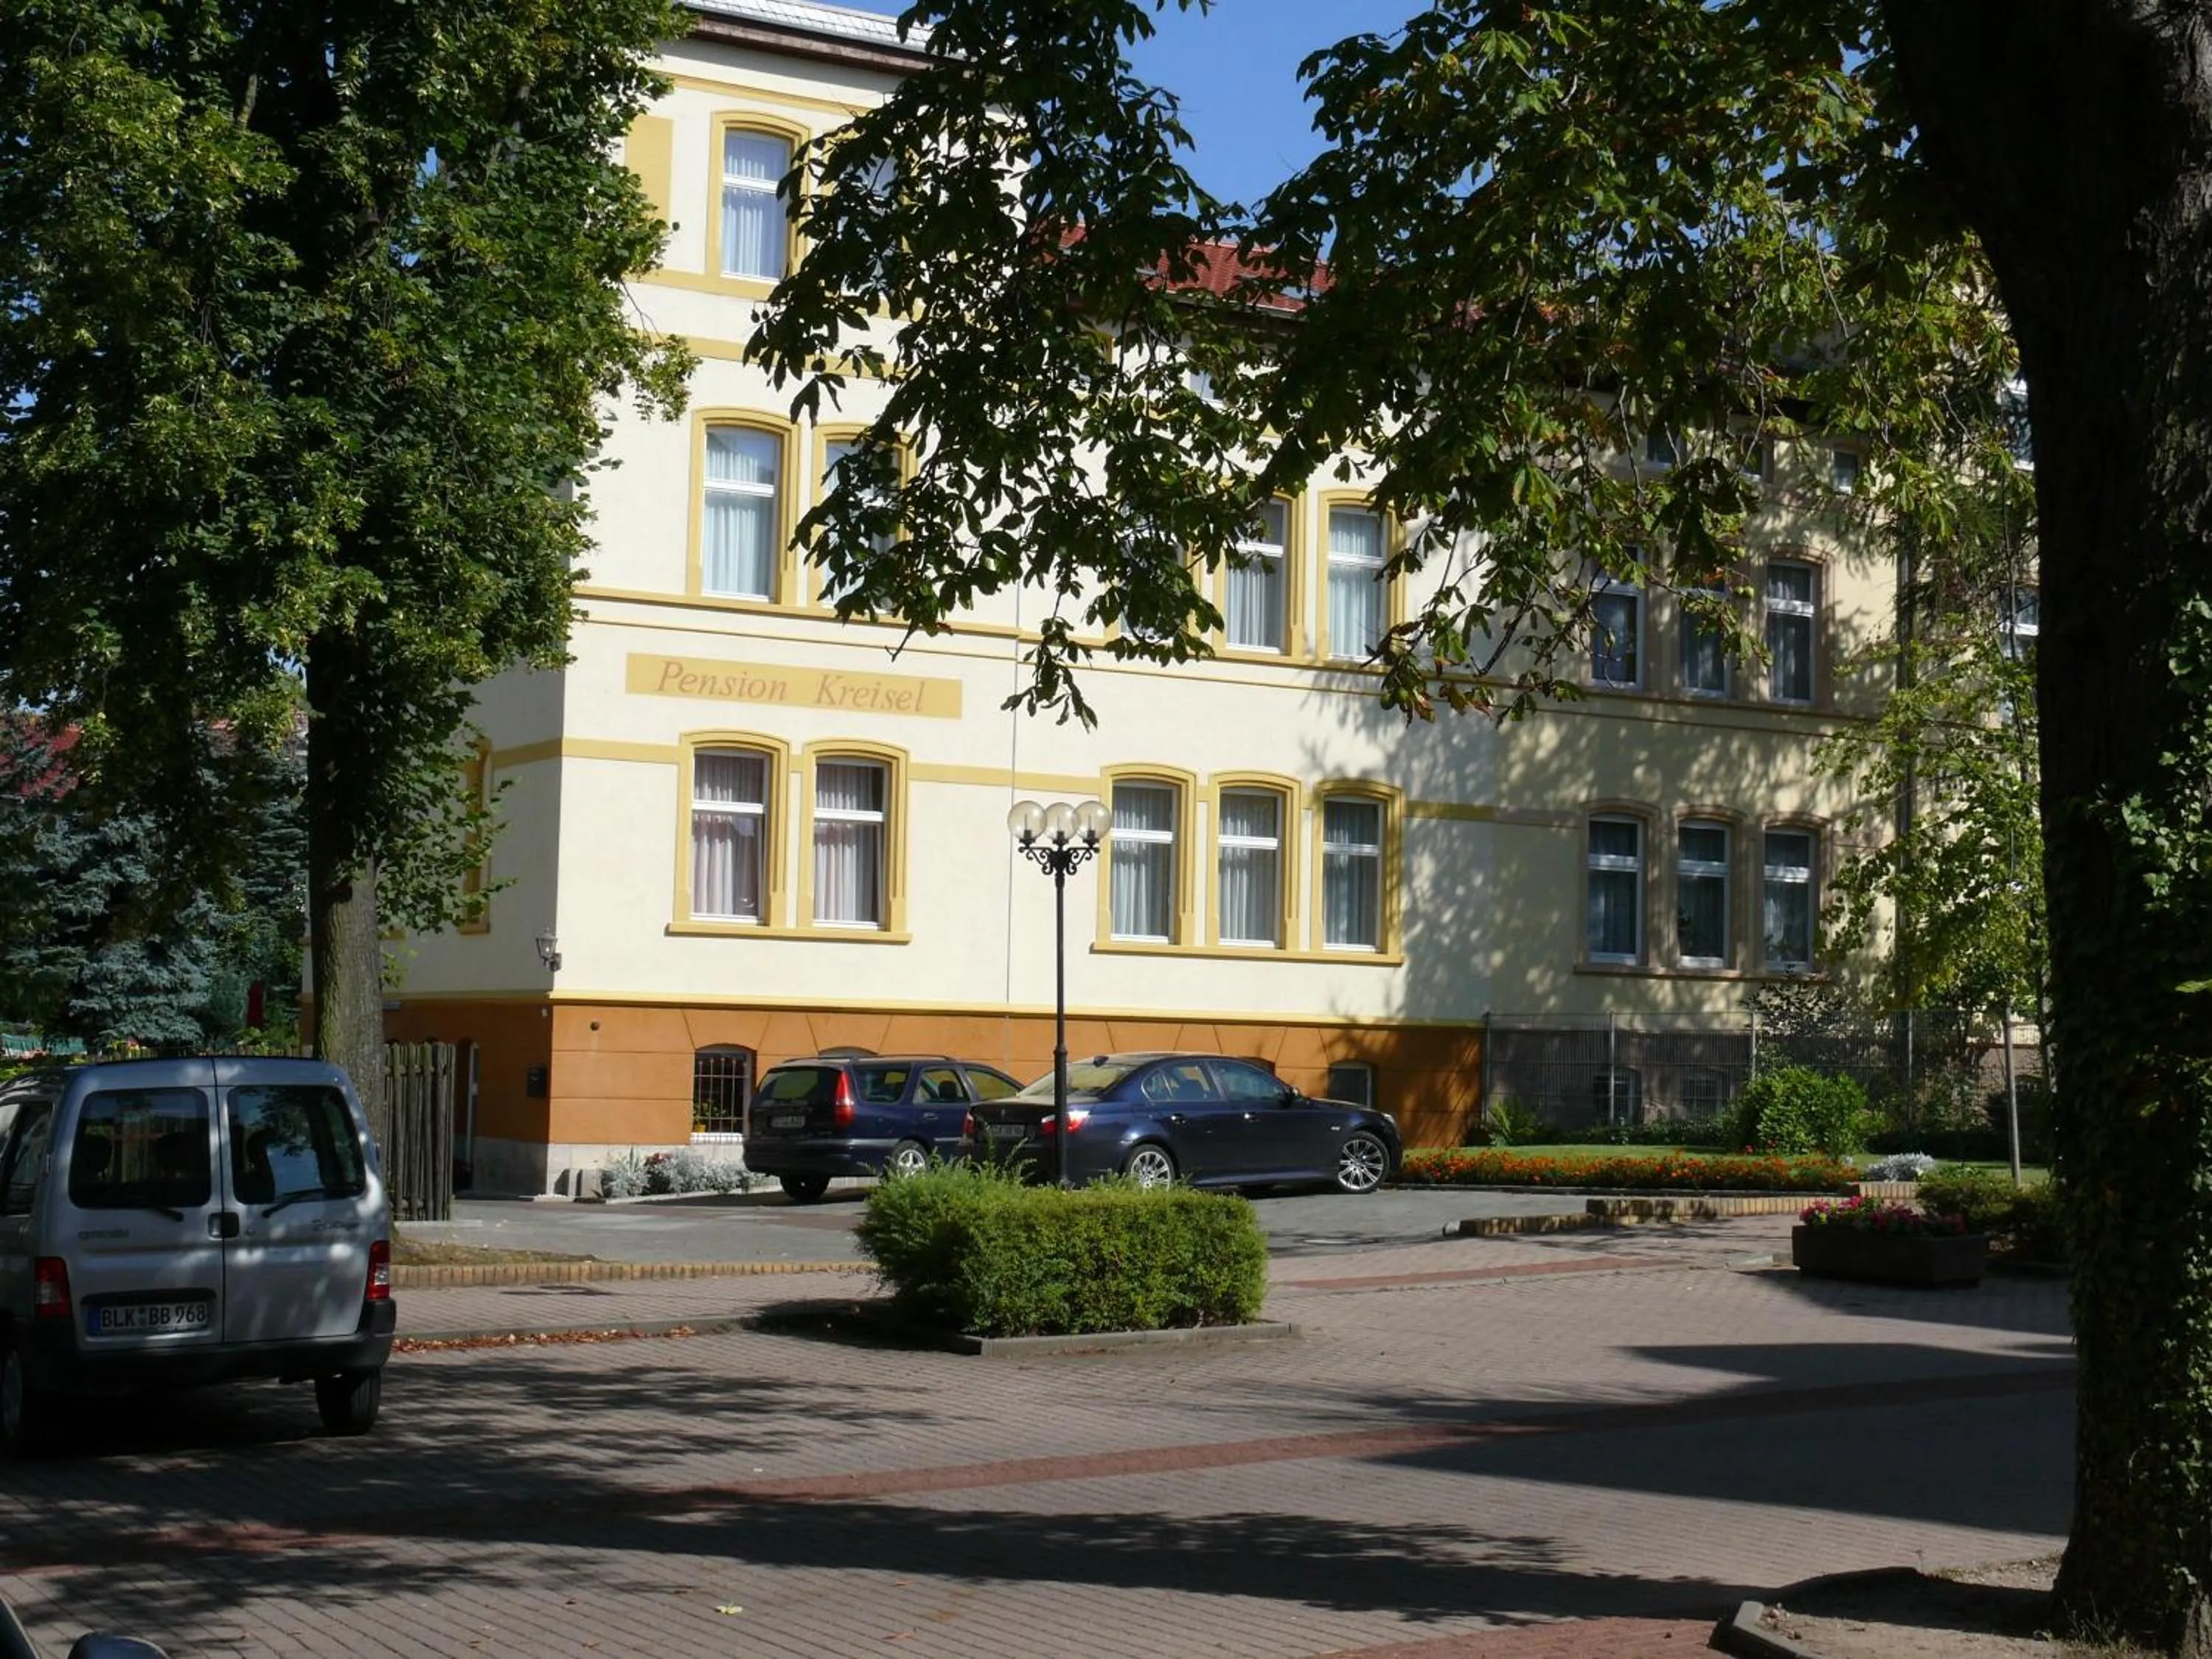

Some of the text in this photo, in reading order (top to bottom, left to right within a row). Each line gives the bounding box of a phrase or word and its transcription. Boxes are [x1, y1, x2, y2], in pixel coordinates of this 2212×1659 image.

[656, 661, 926, 713] Pension Kreisel
[102, 1304, 206, 1327] BLK BB 968
